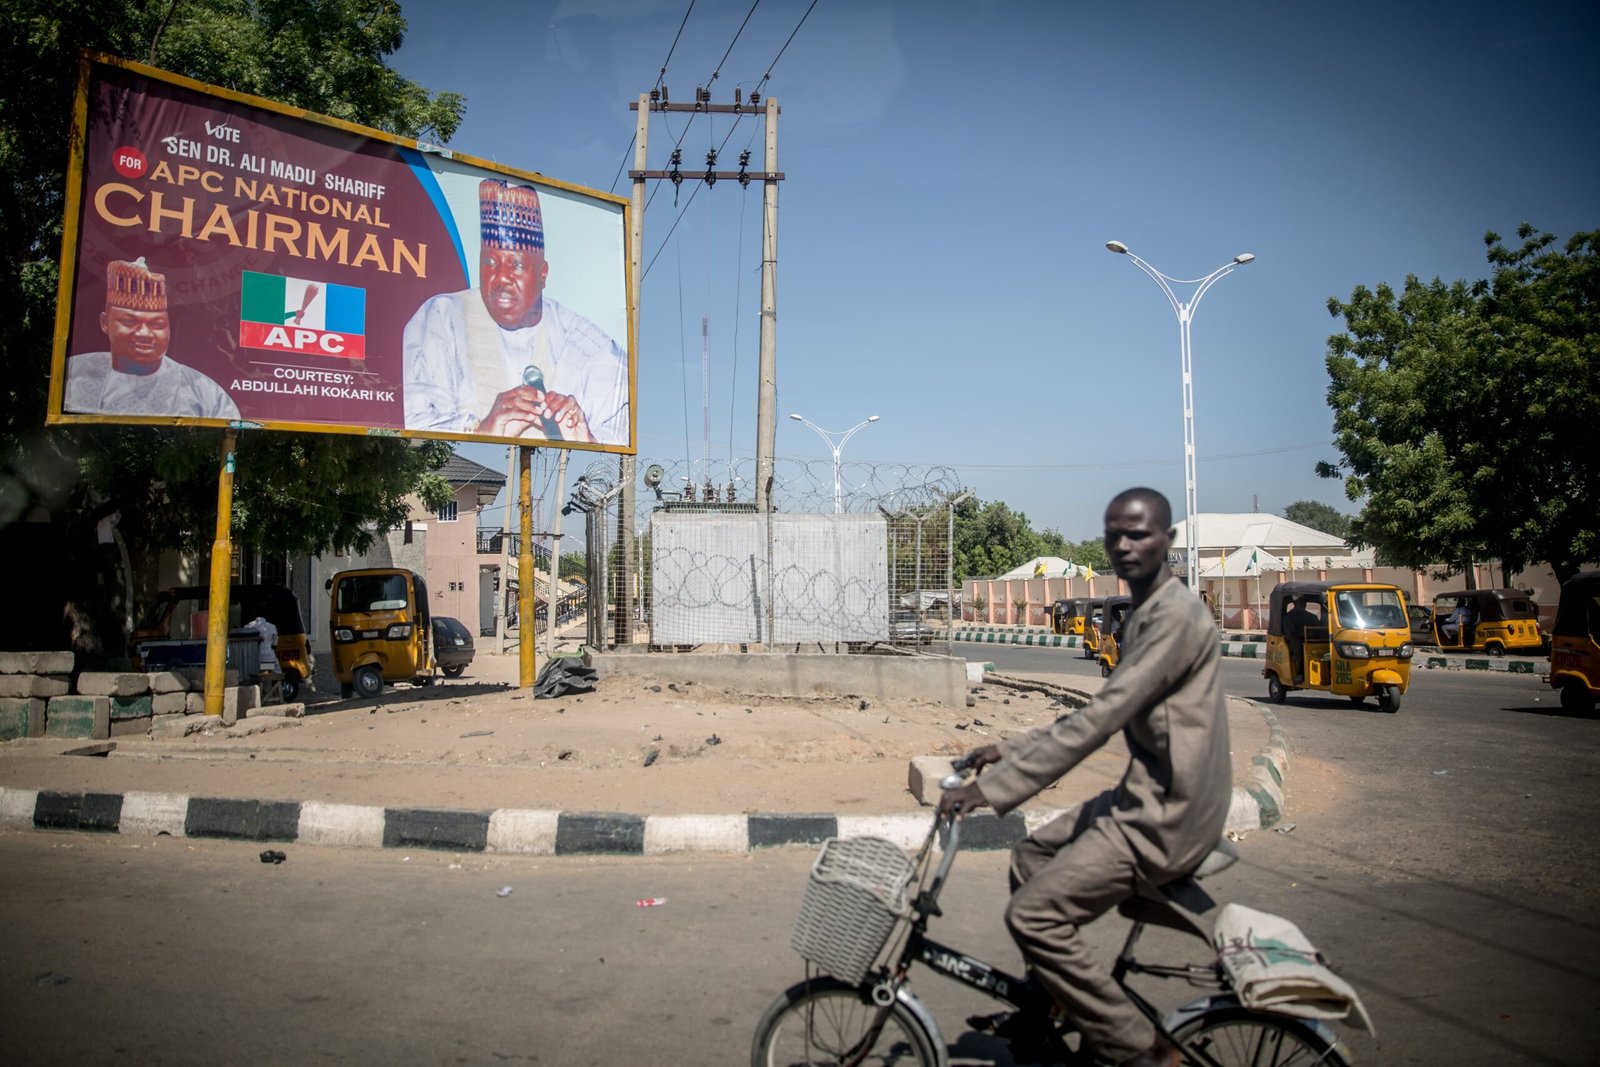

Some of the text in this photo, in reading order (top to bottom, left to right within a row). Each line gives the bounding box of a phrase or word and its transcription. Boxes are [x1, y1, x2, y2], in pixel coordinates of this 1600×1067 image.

[205, 120, 241, 143] VOTE
[119, 155, 141, 170] FOR
[167, 136, 386, 200] SEN DR. ALI MADU SHARIFF
[150, 160, 390, 229] APC NATIONAL
[94, 182, 427, 279] CHAIRMAN
[263, 326, 345, 353] APC
[273, 367, 354, 385] COURTESY:
[230, 379, 395, 402] ABDULLAHI KOKARI KK
